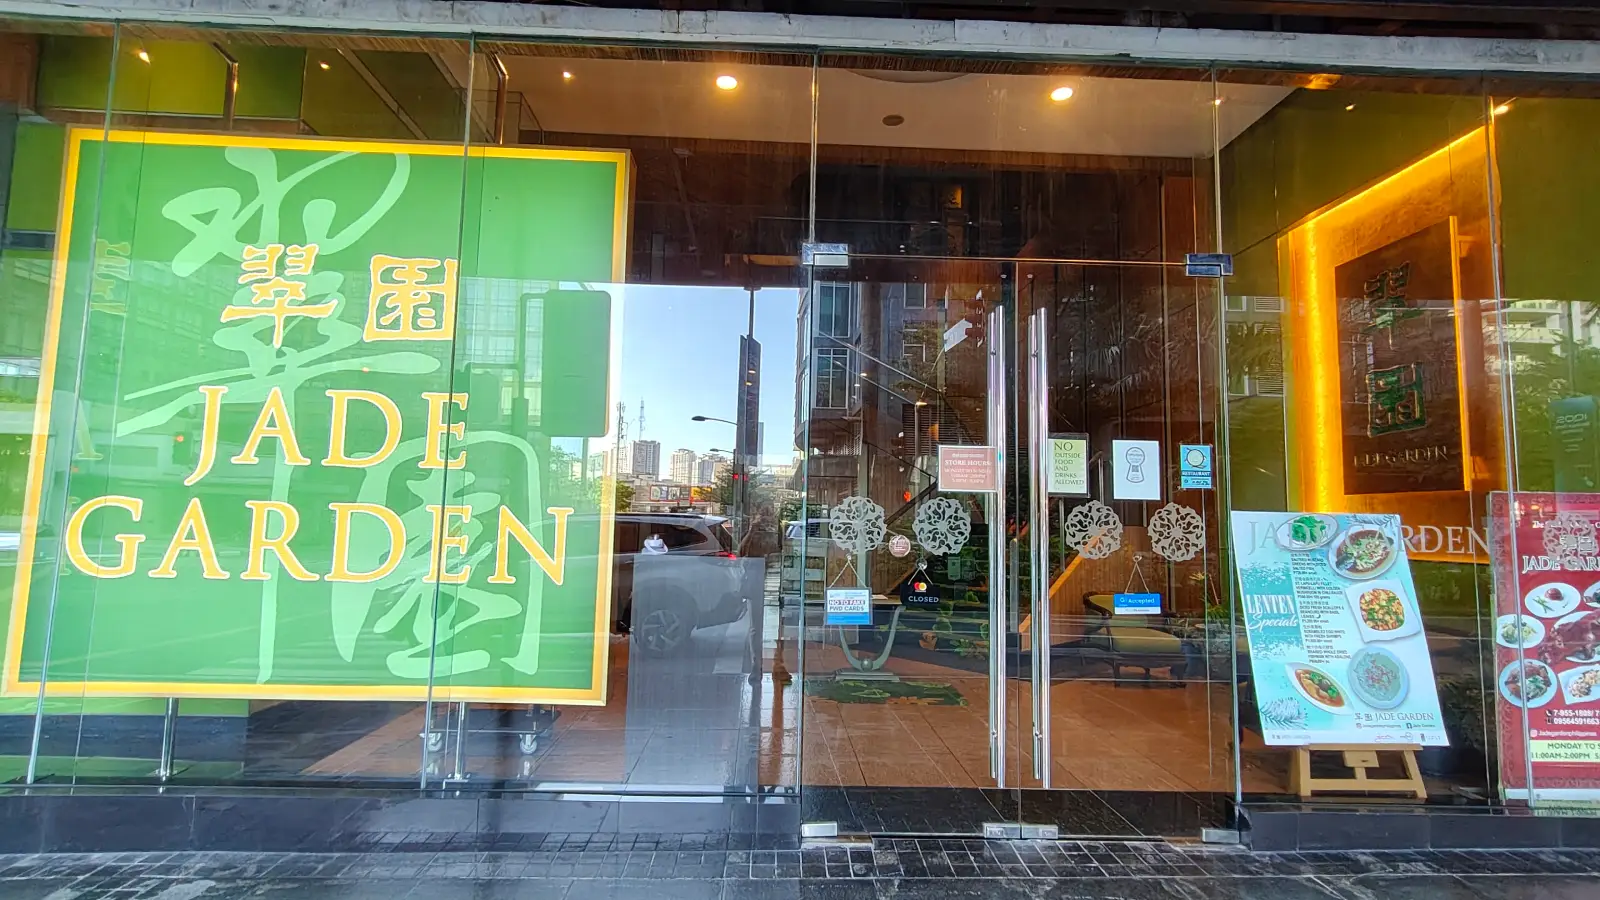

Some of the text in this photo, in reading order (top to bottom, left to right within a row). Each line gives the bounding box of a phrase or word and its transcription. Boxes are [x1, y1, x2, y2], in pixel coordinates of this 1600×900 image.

[184, 385, 470, 486] JADE
[1054, 441, 1073, 451] NO
[65, 495, 574, 587] GARDEN
[1246, 594, 1295, 614] LENTEN
[1247, 613, 1299, 633] Specials
[1375, 712, 1434, 722] JADE GARDEN
